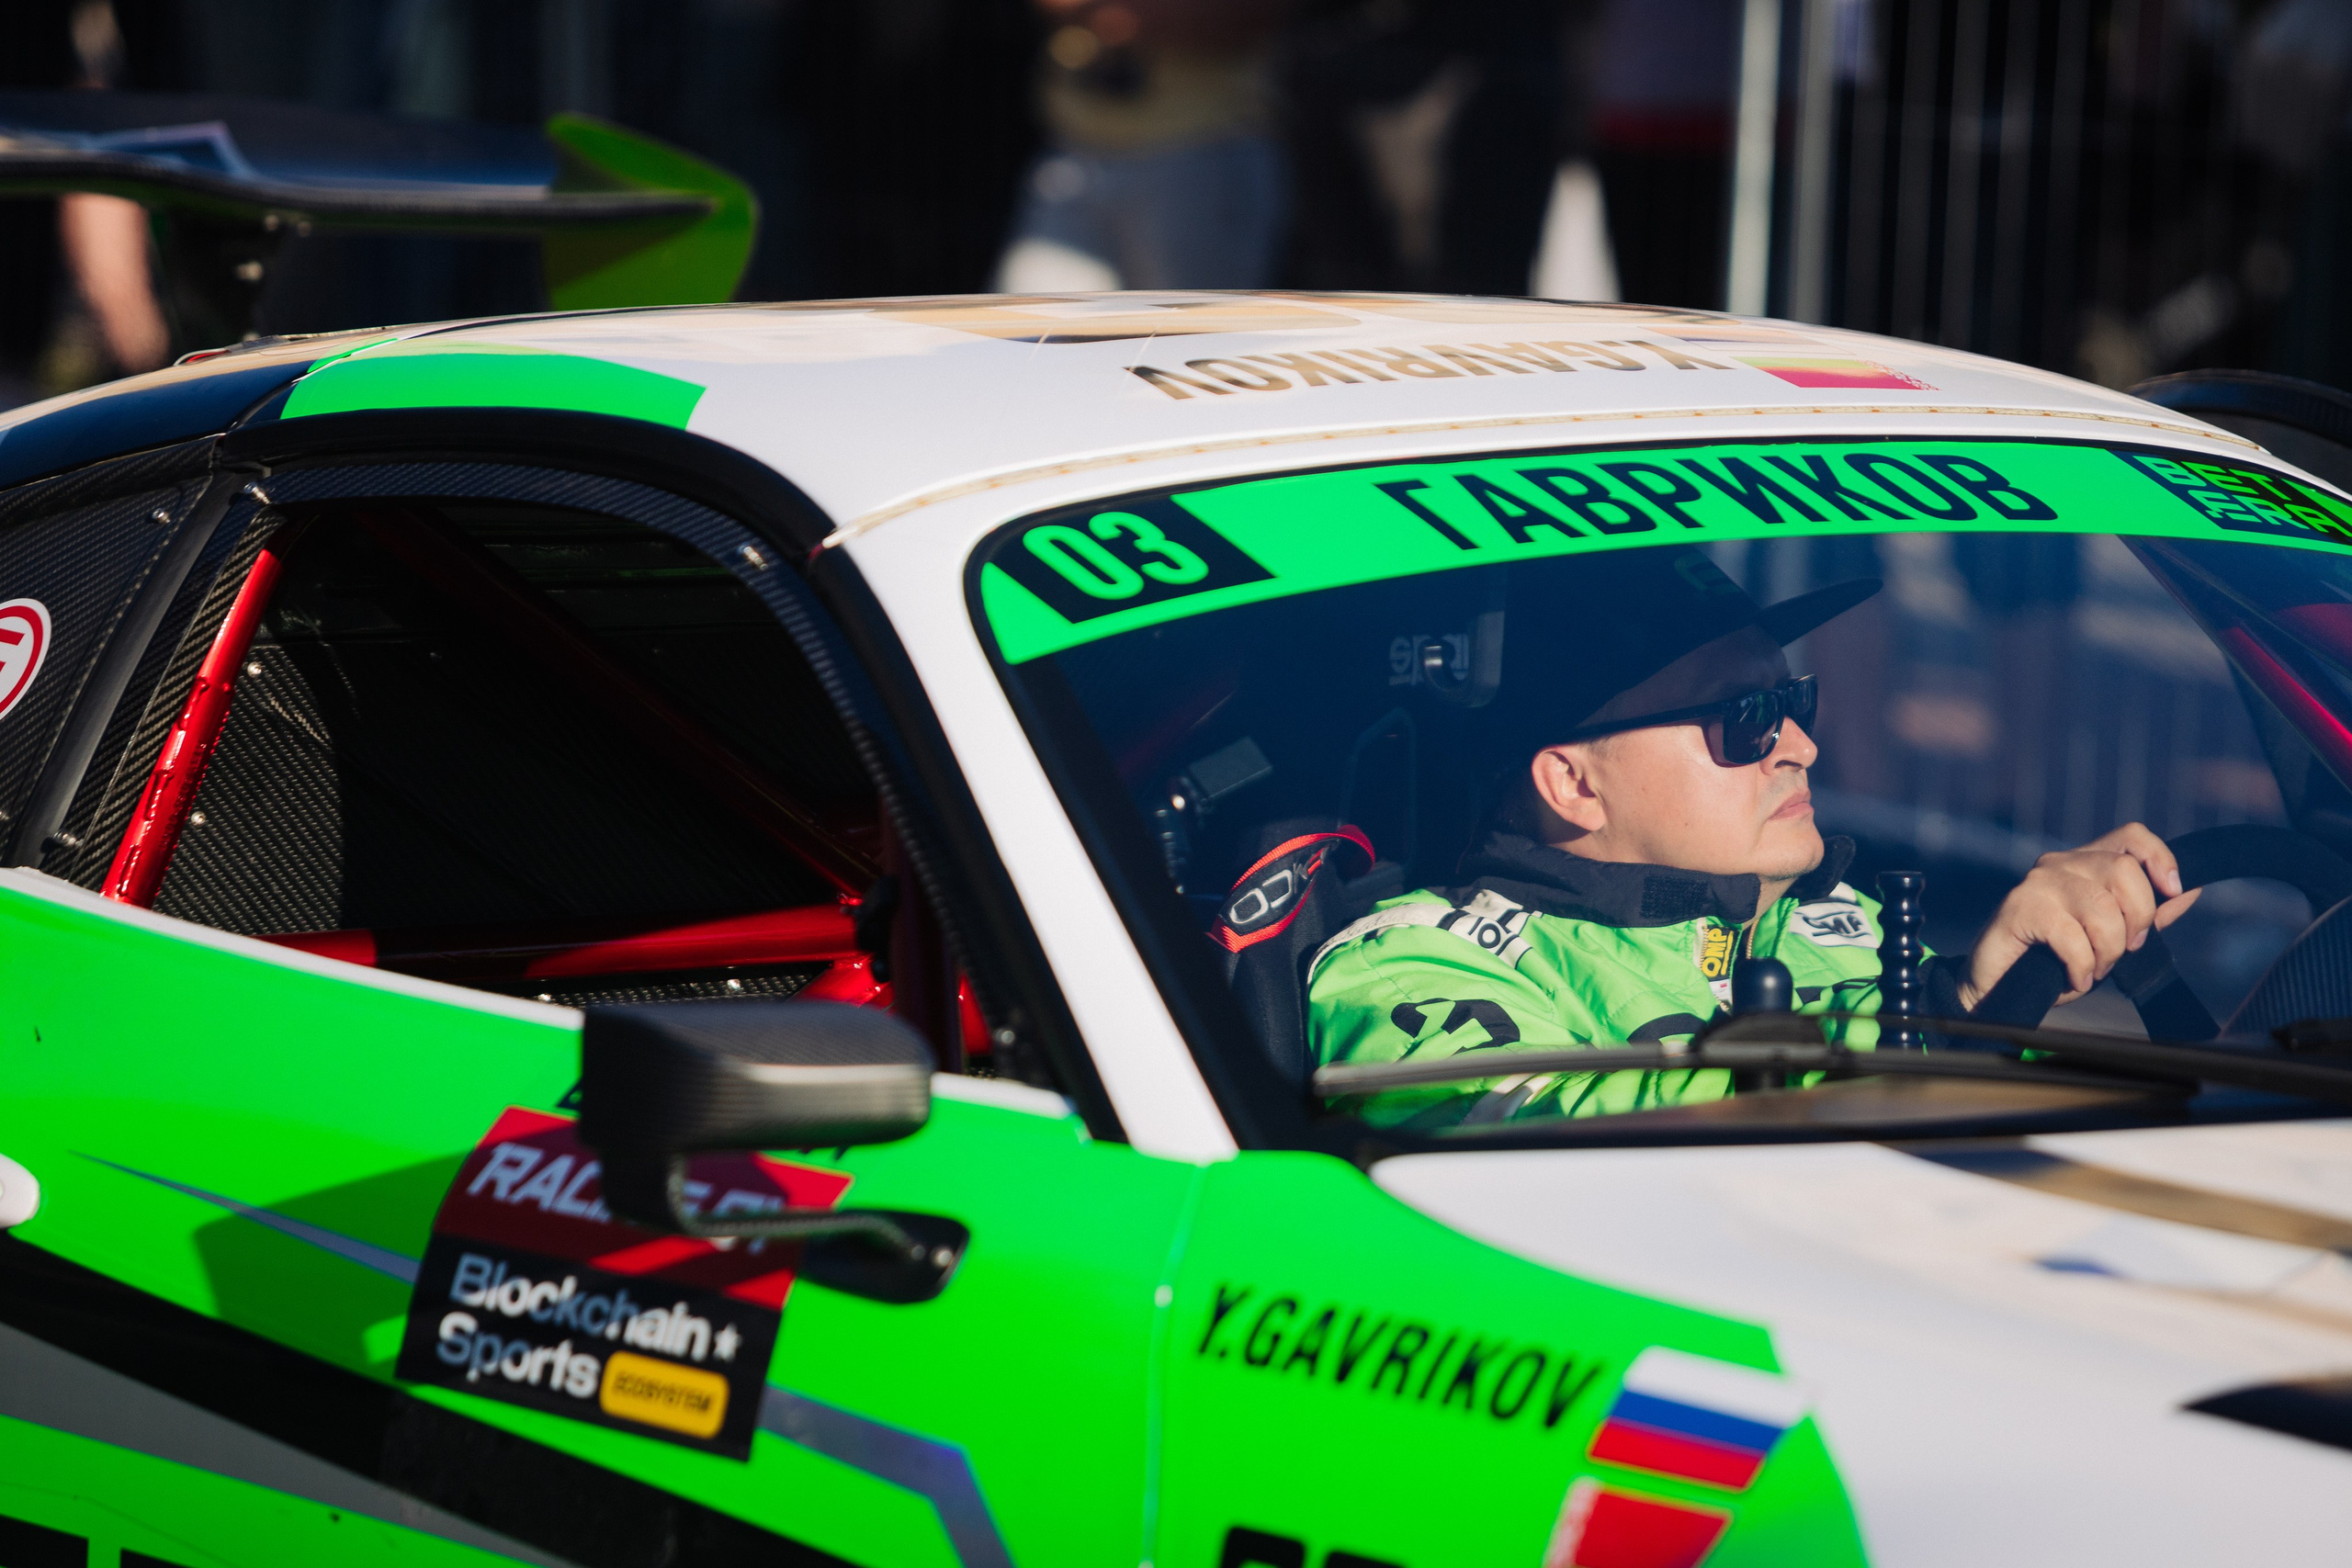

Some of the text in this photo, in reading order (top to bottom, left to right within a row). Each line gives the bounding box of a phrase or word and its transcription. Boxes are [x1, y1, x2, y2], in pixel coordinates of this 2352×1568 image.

[1372, 453, 2058, 550] ГАВРИКОВ
[1022, 511, 1209, 600] 03
[1702, 927, 1728, 978] OMP
[448, 1252, 713, 1361] Blockchain
[436, 1311, 601, 1399] Sports
[1198, 1281, 1606, 1429] Y.GAVRIKOV
